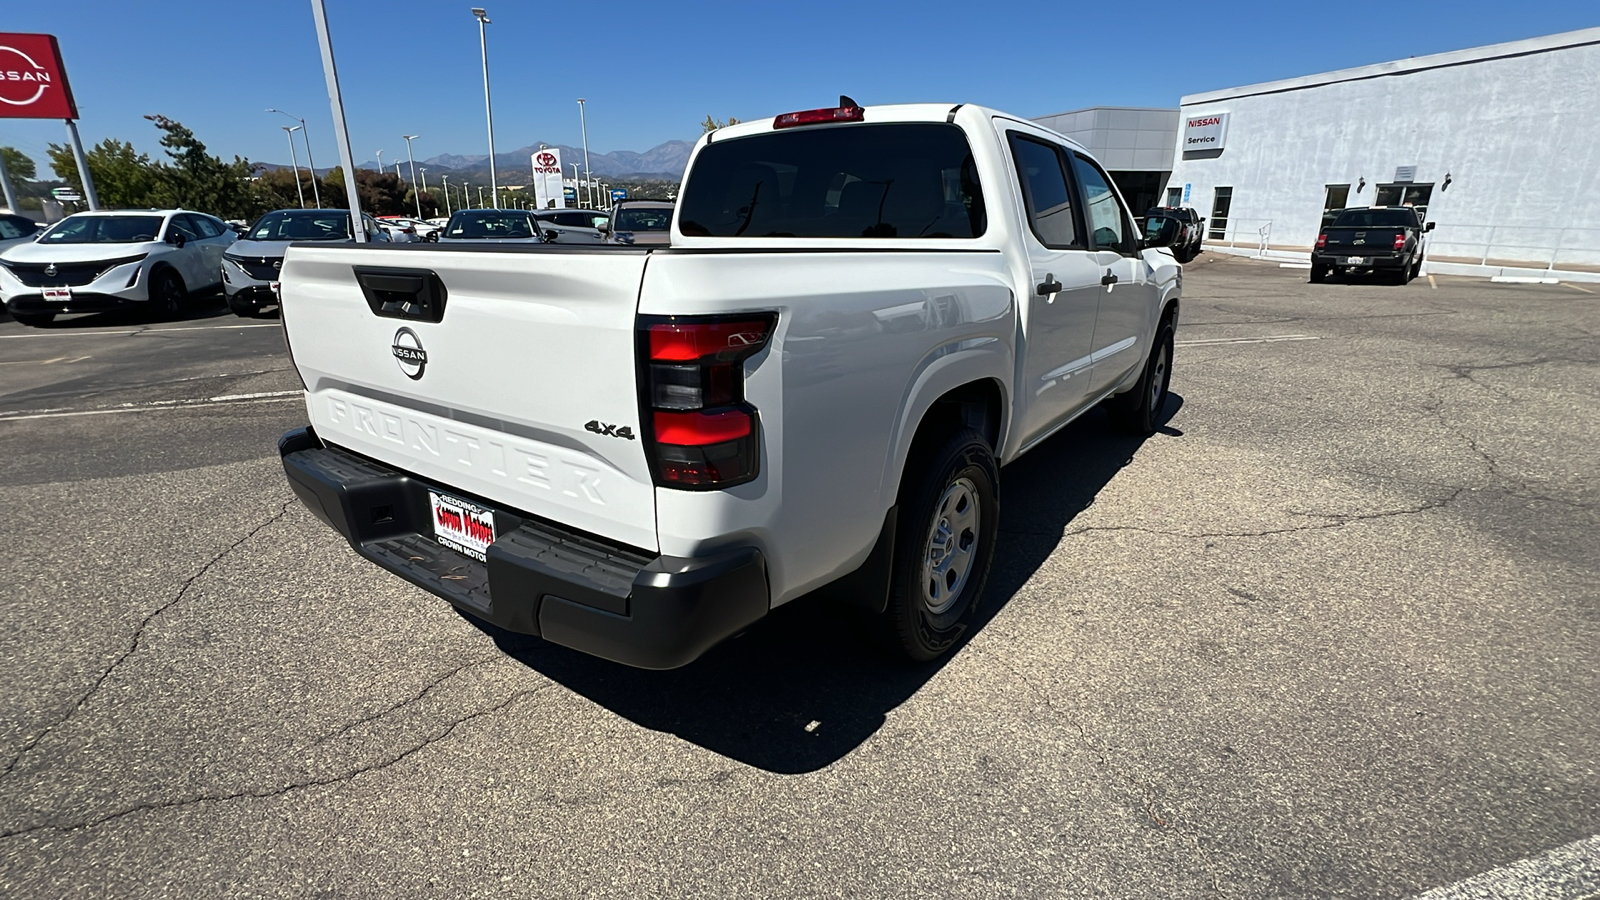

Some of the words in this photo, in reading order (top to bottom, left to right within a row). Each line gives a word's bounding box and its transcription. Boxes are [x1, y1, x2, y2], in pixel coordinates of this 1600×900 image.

[1189, 117, 1221, 128] NISSAN
[1188, 136, 1216, 145] Service
[327, 395, 605, 505] FRONTIER
[435, 506, 463, 534] Crown
[463, 508, 494, 545] Motors
[437, 536, 463, 553] CROWN
